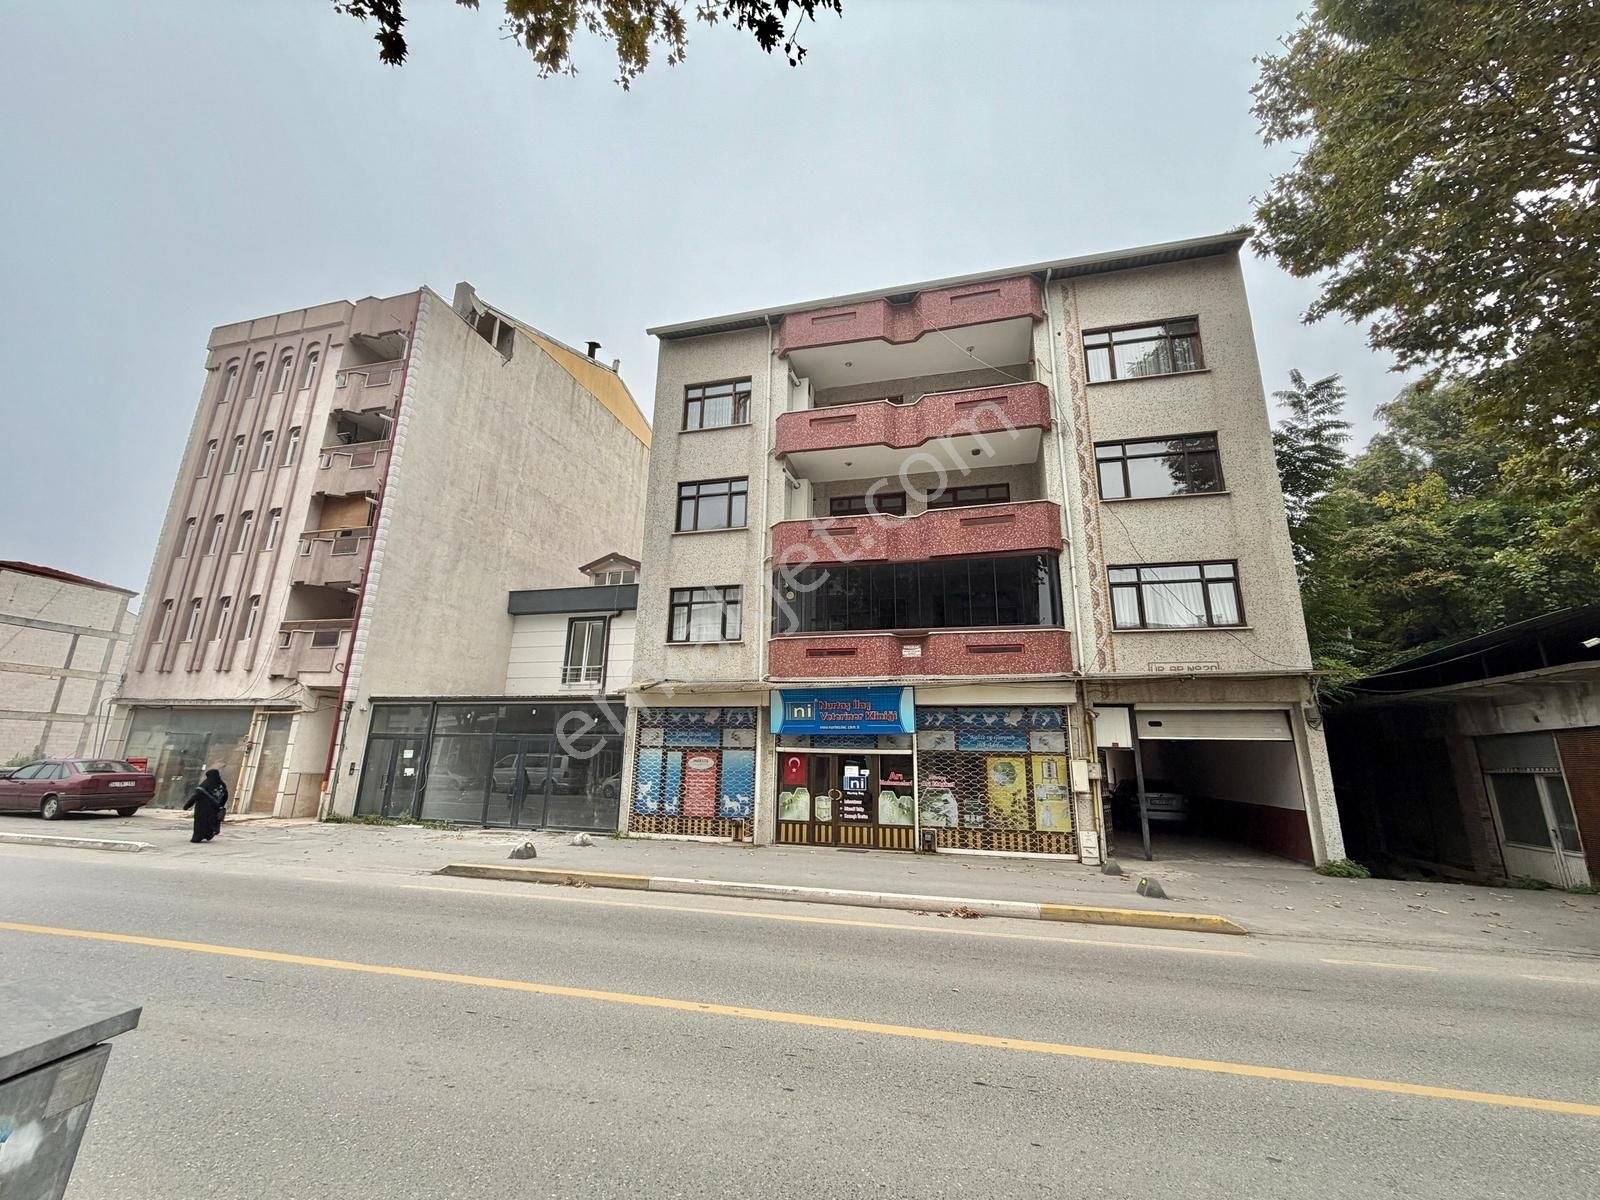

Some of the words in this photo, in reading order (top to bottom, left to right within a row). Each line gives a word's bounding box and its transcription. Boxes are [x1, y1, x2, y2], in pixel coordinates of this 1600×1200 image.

[819, 700, 851, 711] Nurtaş
[852, 698, 871, 711] İlaç
[793, 704, 811, 718] ni
[819, 711, 863, 721] Veteriner
[865, 710, 898, 722] Kliniği
[850, 778, 864, 789] ni
